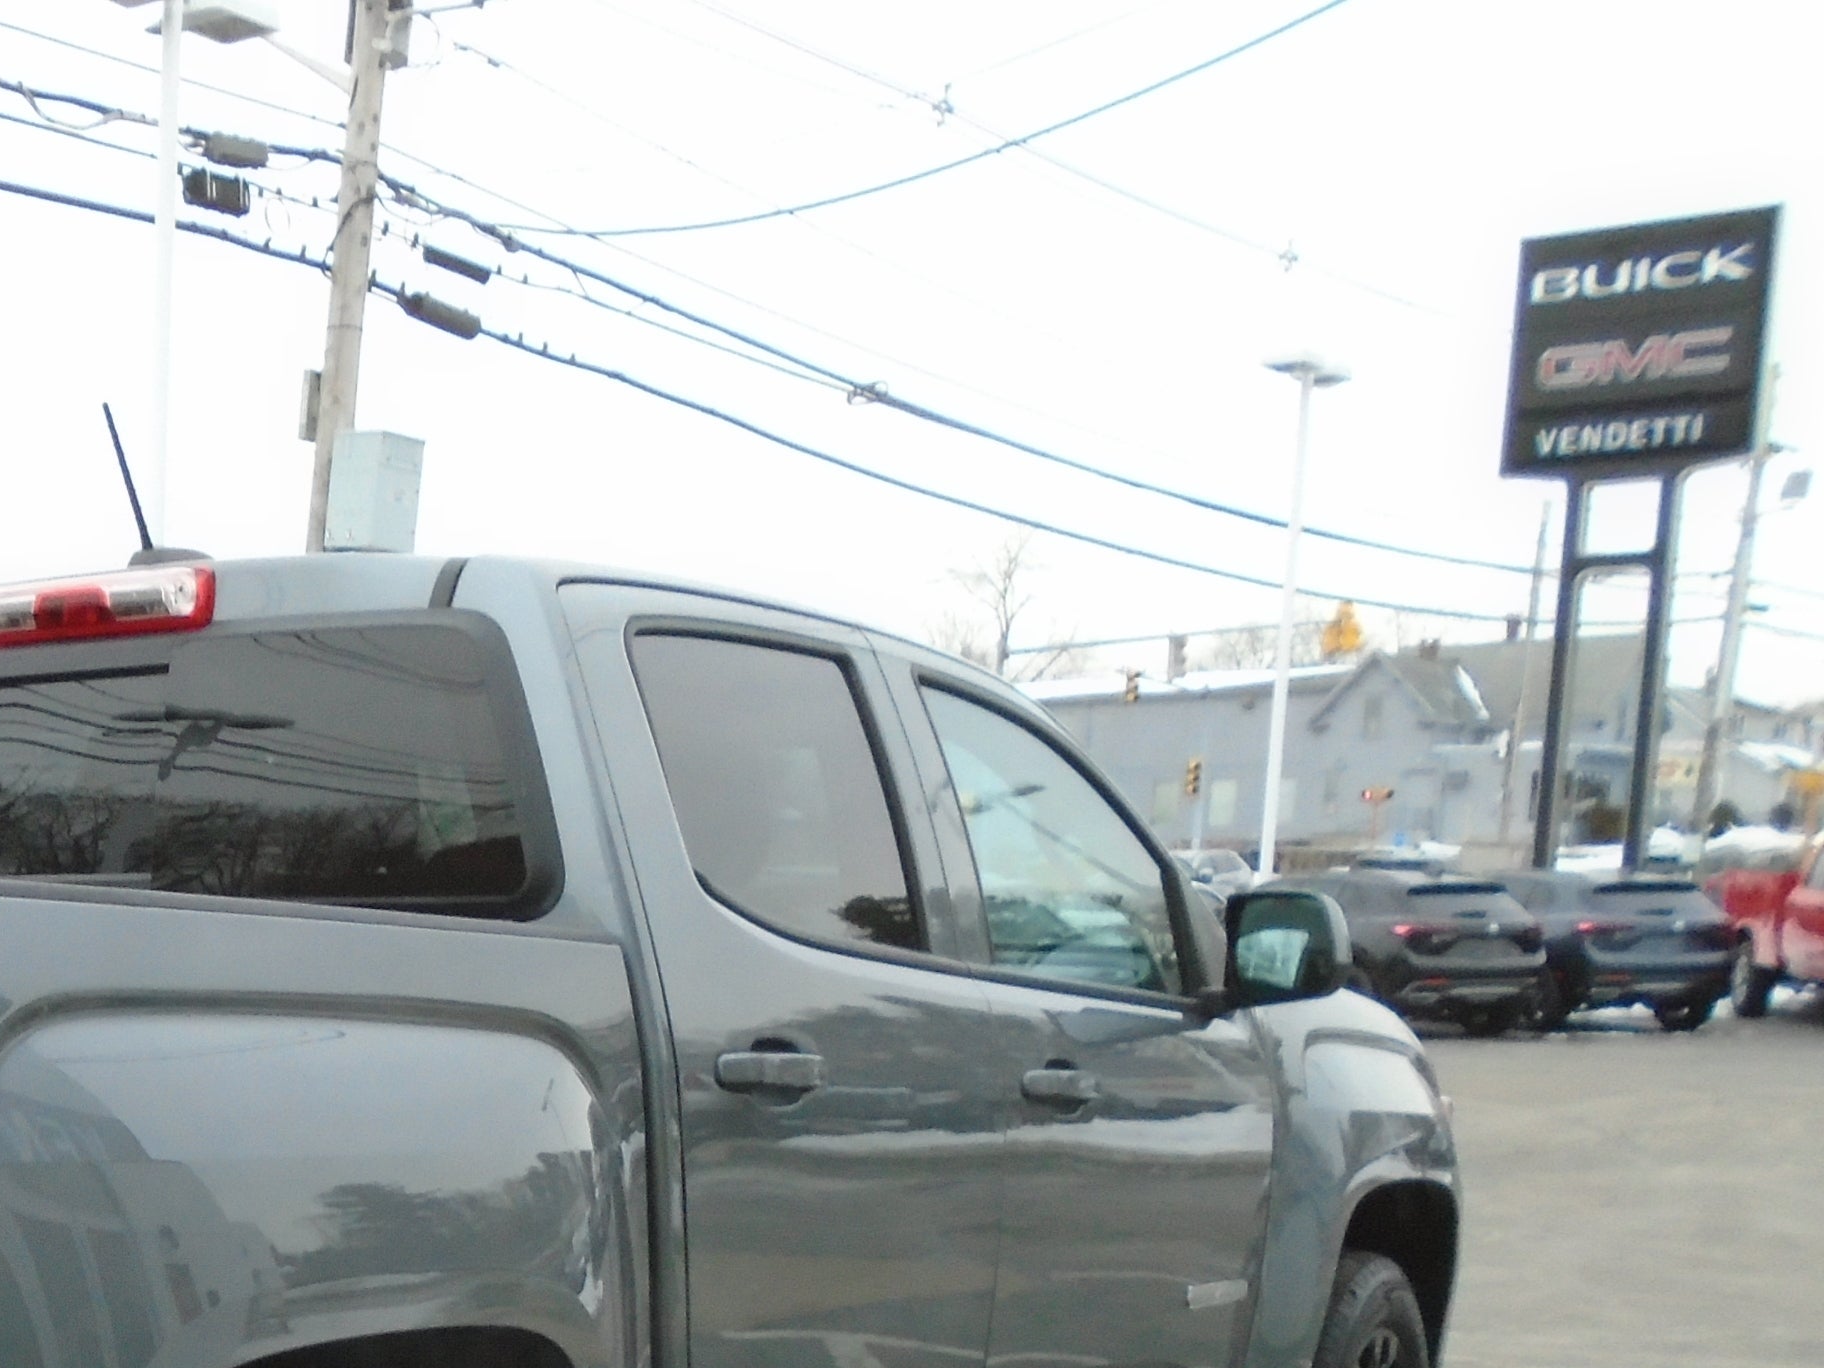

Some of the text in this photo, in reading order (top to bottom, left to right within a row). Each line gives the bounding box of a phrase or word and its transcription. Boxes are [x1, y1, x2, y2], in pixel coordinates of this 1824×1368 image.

[1531, 243, 1756, 303] BUICK
[1537, 326, 1733, 390] GMC
[1536, 412, 1705, 454] VENDETTI
